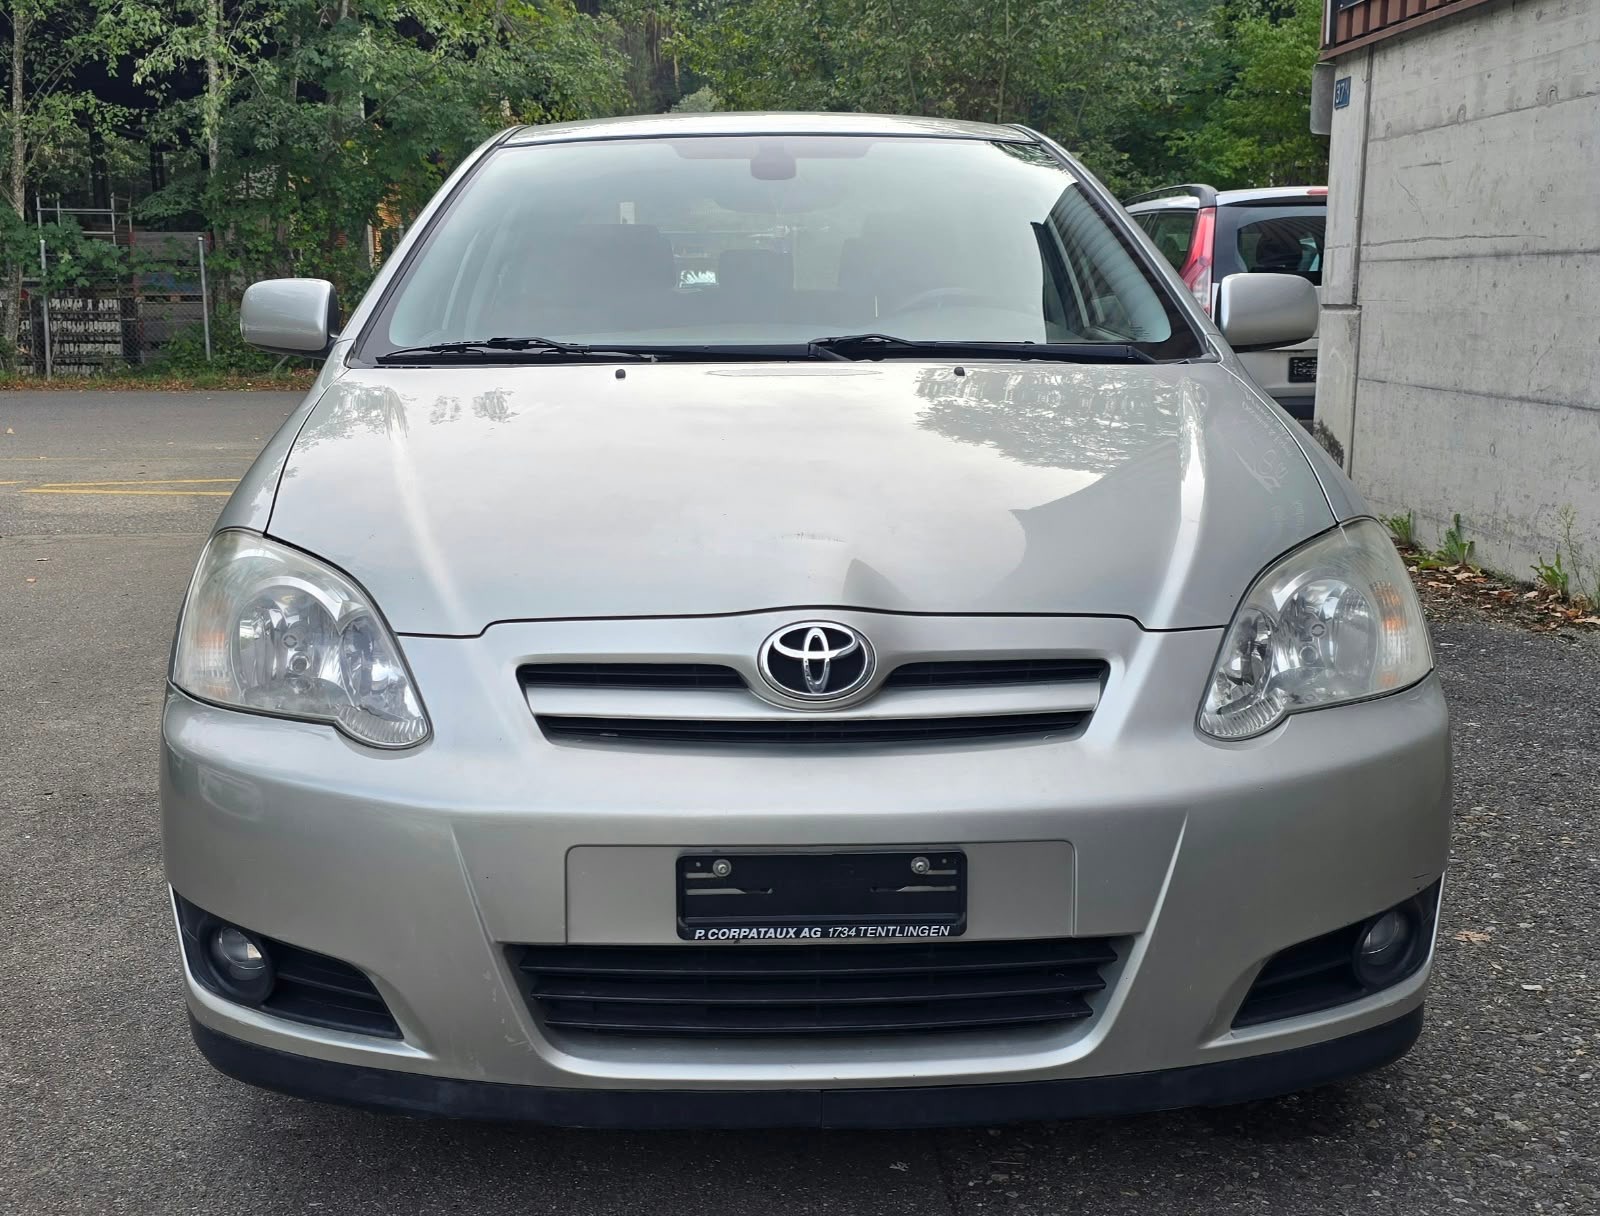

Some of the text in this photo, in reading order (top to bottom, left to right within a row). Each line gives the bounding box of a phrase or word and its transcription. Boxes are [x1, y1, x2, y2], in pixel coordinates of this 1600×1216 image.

[799, 927, 822, 938] AG
[828, 926, 856, 938] 1734
[859, 925, 950, 937] TENTLINGEN
